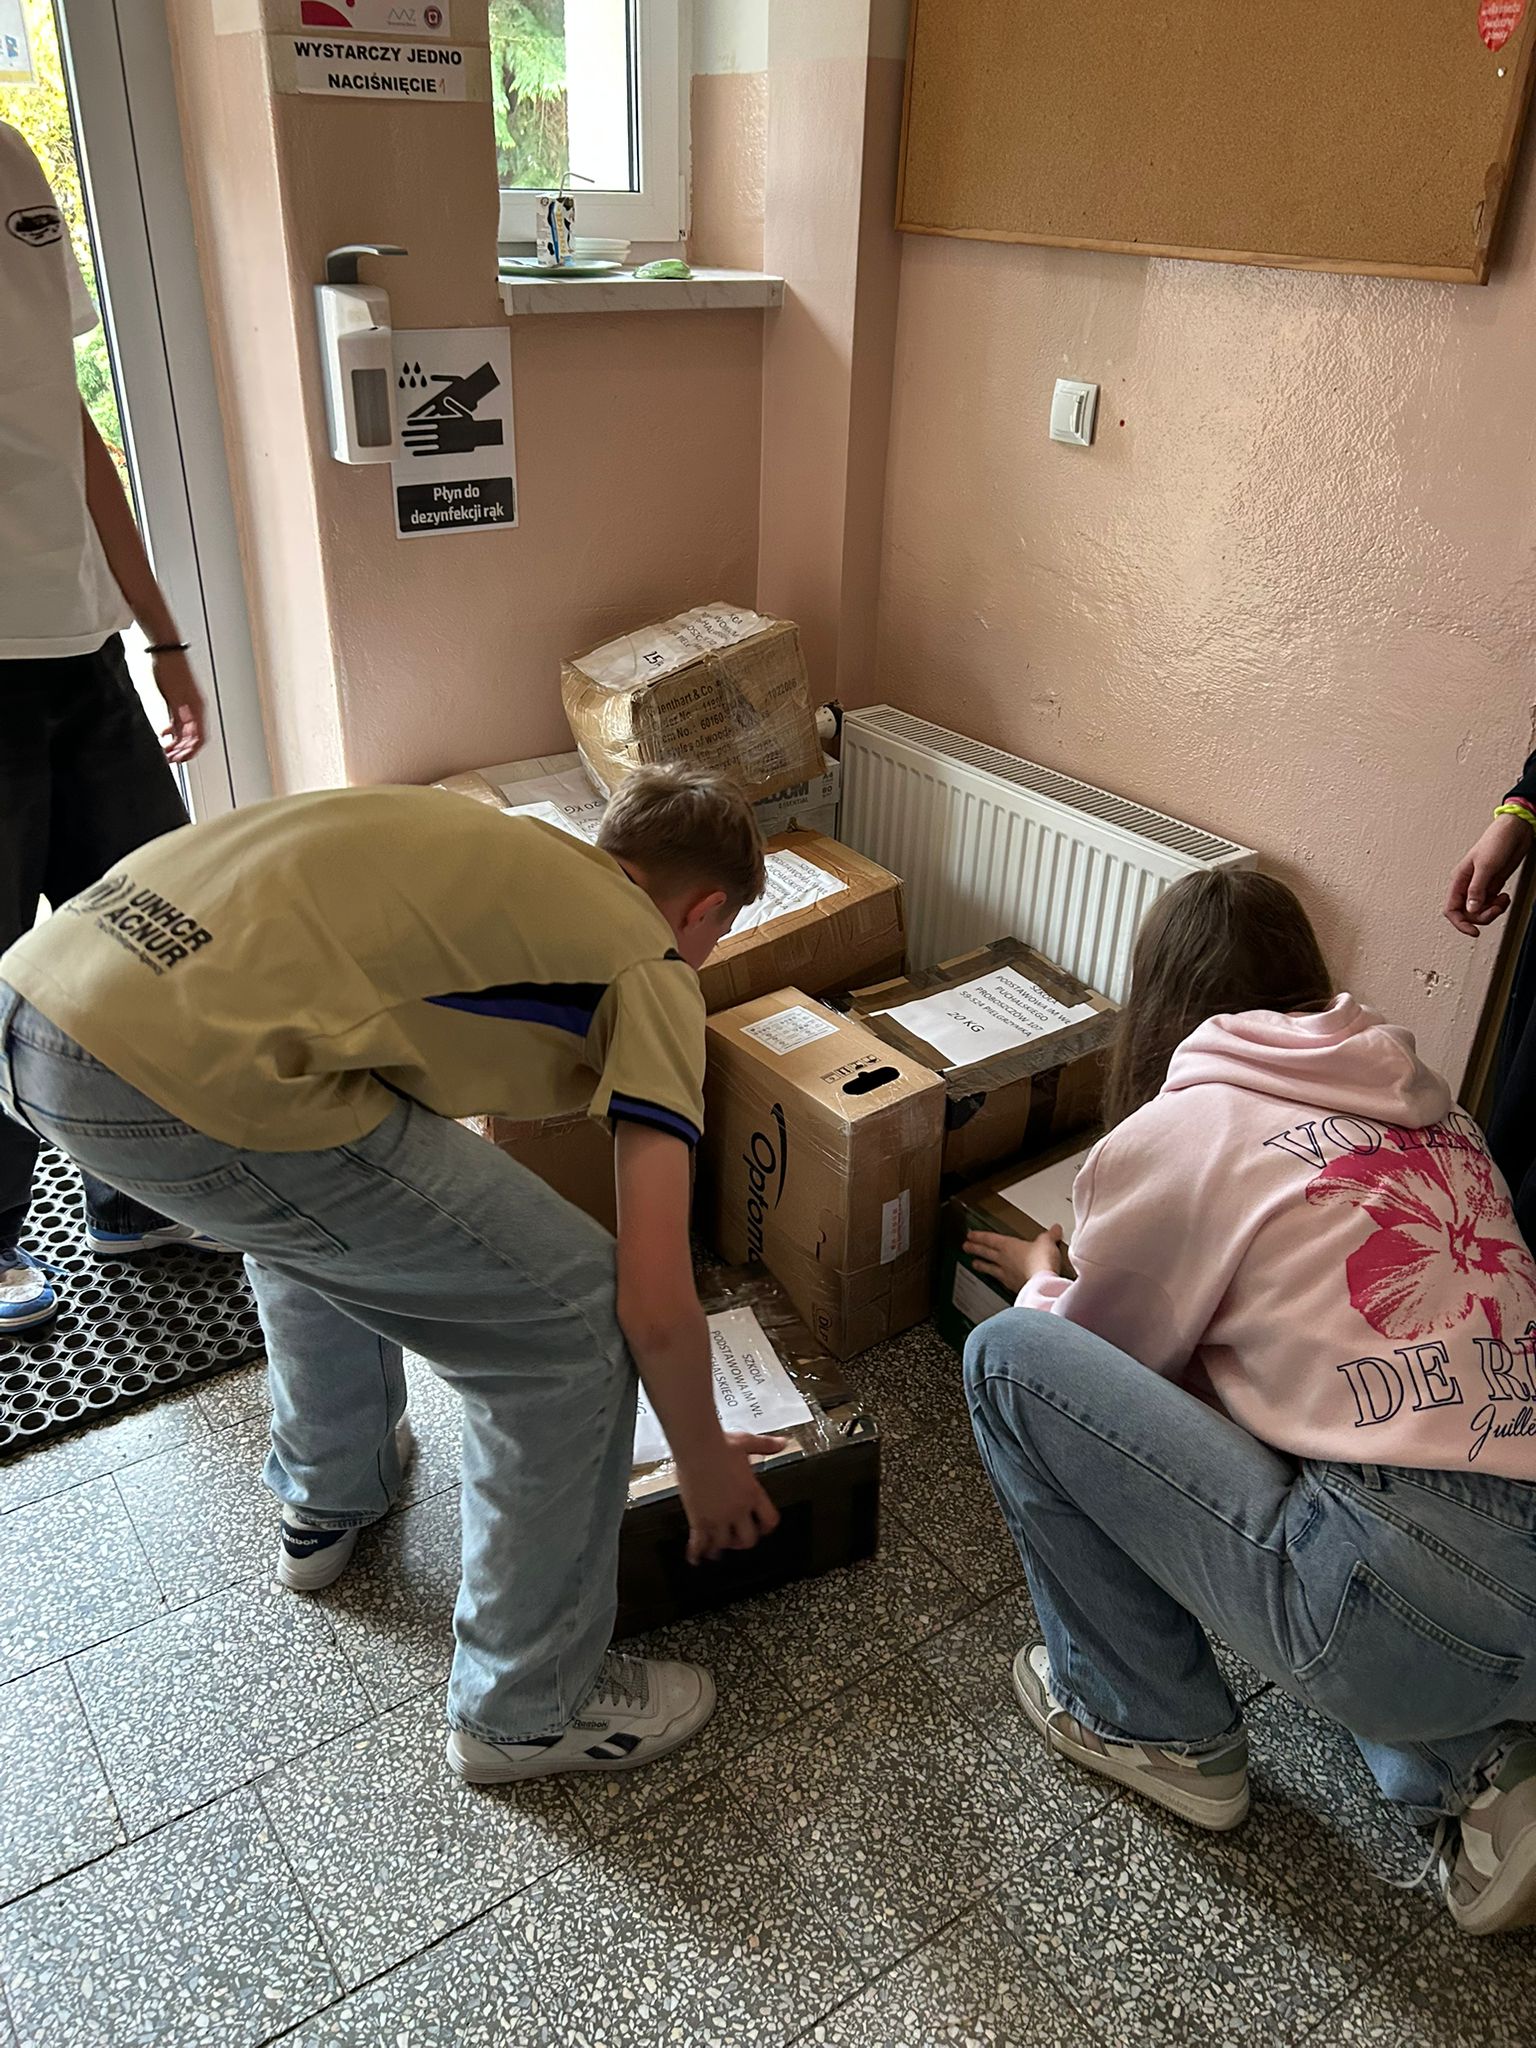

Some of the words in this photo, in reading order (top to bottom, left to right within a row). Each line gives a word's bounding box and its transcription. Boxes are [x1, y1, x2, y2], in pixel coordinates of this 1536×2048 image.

[294, 41, 401, 62] WYSTARCZY
[407, 48, 462, 65] JEDNO
[328, 72, 437, 95] NACIŚNIĘCIE
[433, 487, 463, 503] Płyn
[463, 484, 480, 499] do
[410, 505, 482, 525] dezynfekcji
[483, 502, 505, 521] rąk
[103, 905, 190, 969] ACNUR
[129, 888, 214, 953] UNHCR
[995, 975, 1048, 1010] PODSTAWOWA
[995, 985, 1048, 1021] PUCHALSKIEGO
[946, 1010, 967, 1021] 20
[963, 1019, 985, 1033] KG
[711, 1330, 749, 1391] PODSTAWOWA
[742, 1390, 756, 1402] IM
[749, 1401, 764, 1418] WŁ
[711, 1353, 738, 1407] CHALSKIEGO
[742, 1353, 766, 1385] SZKOŁA
[1336, 1340, 1464, 1428] DE
